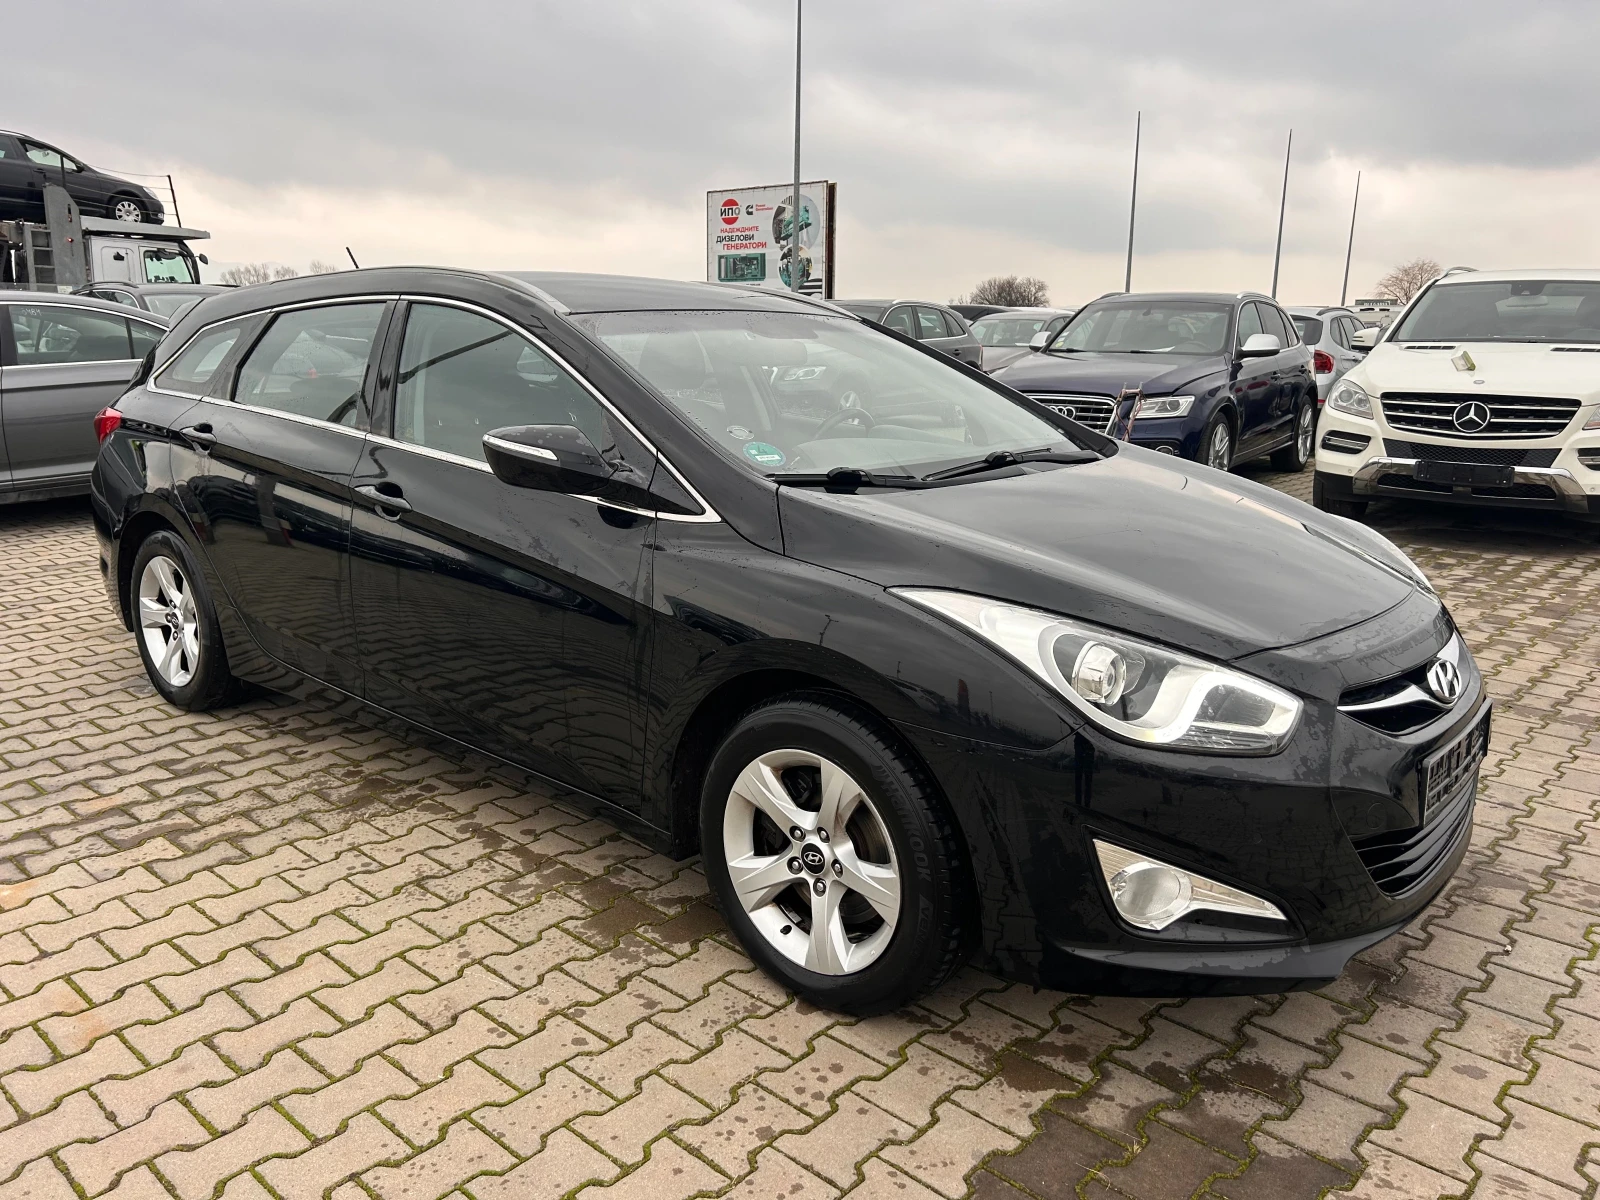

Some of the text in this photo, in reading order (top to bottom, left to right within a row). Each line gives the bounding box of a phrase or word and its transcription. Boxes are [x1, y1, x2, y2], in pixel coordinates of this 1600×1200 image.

[720, 207, 741, 217] ИПО
[720, 226, 760, 234] НАДЕЖДНИТЕ
[716, 234, 755, 243] ДИЗЕЛОВИ
[723, 242, 767, 250] ГЕНЕРАТОРИ
